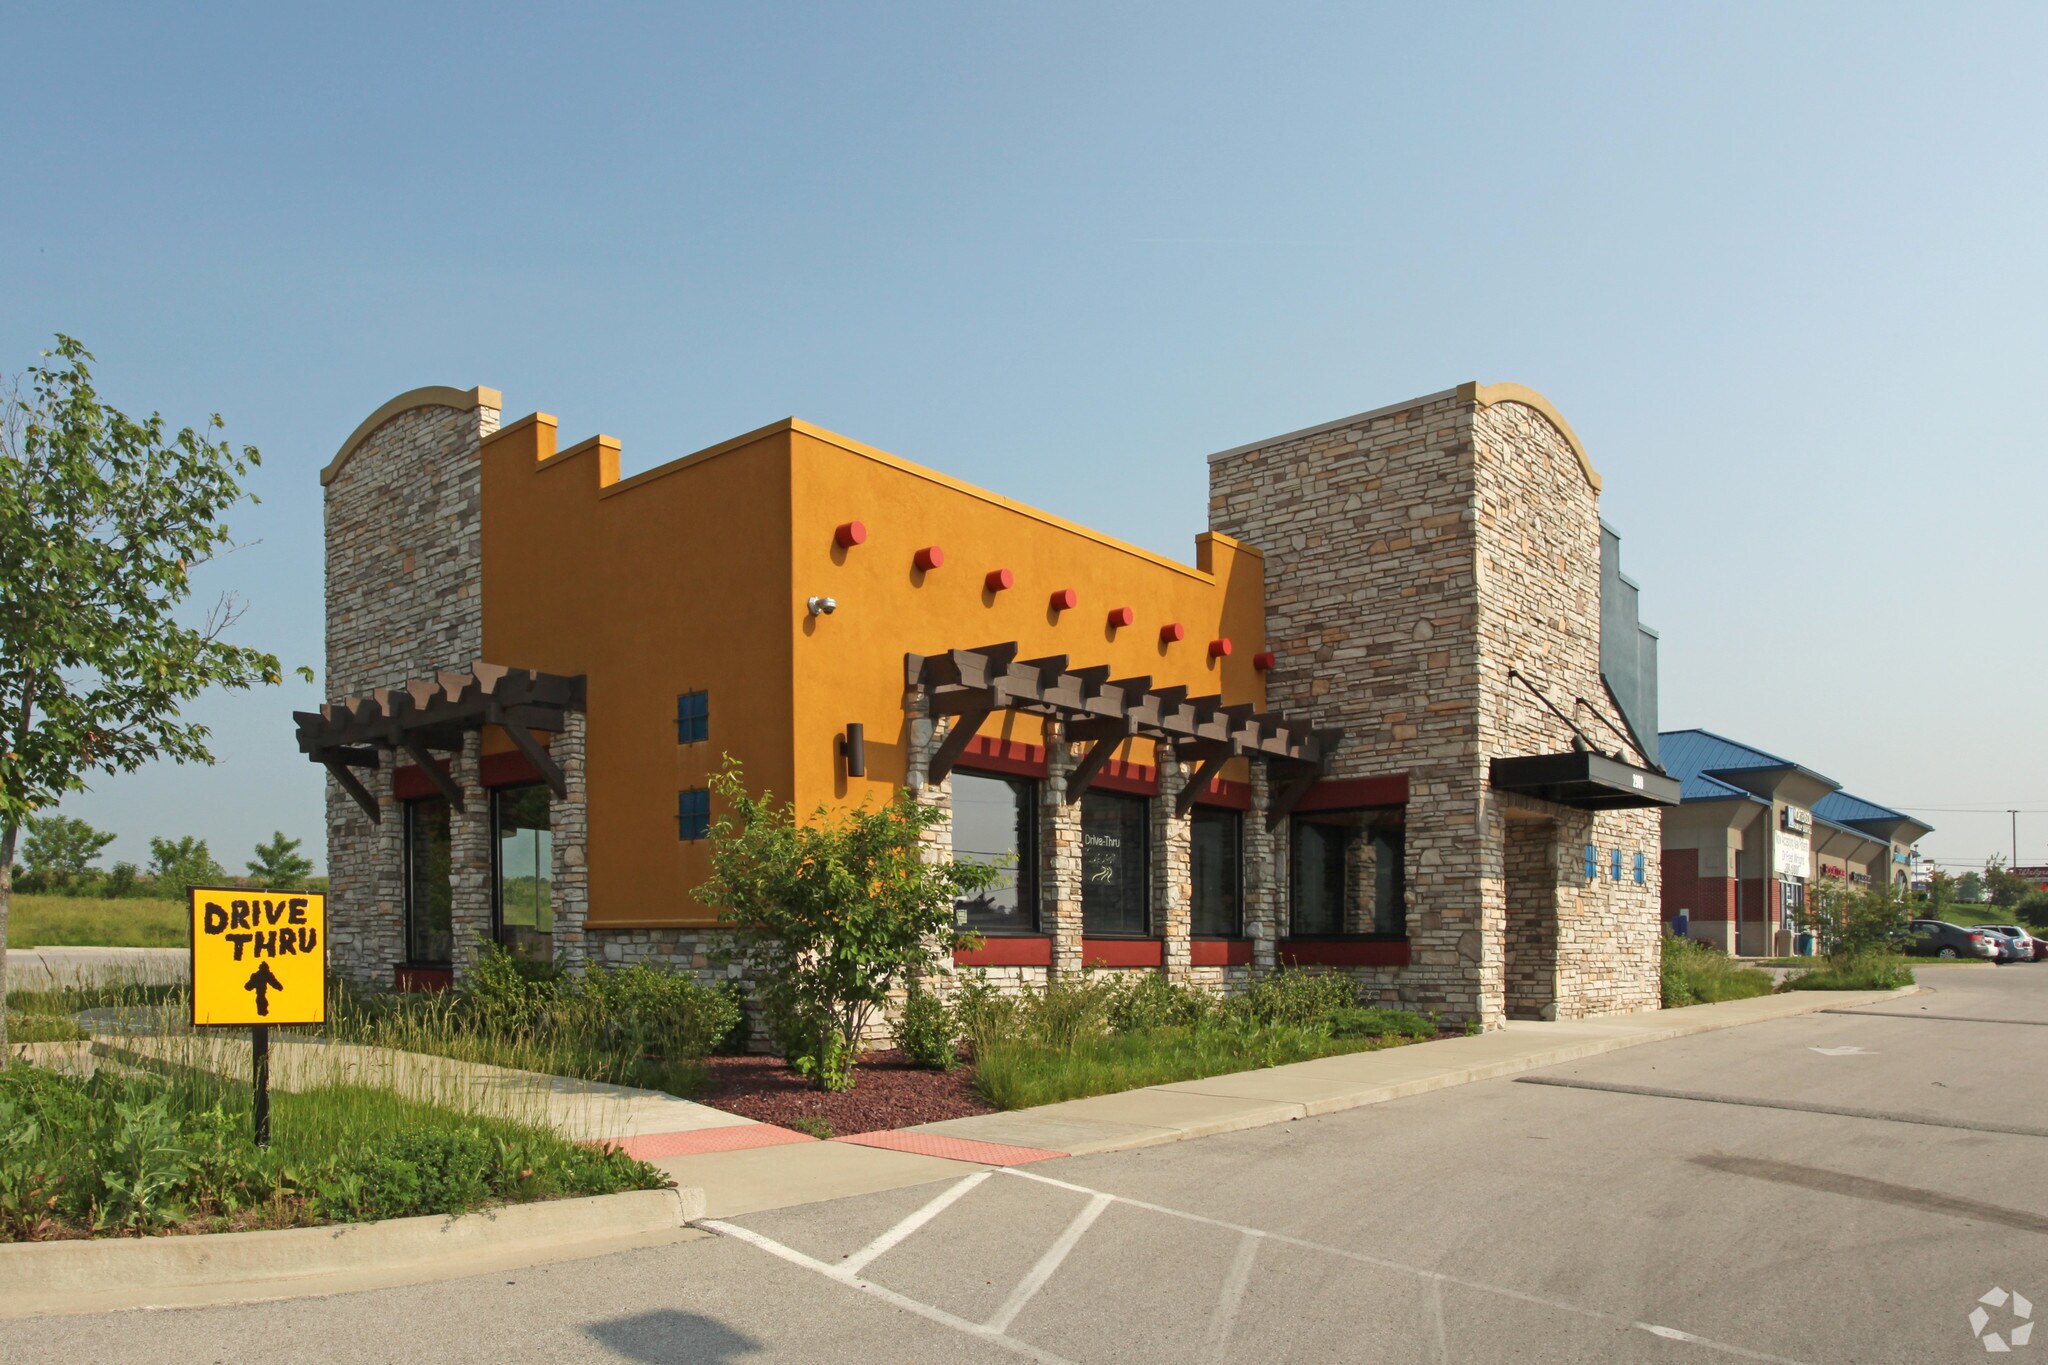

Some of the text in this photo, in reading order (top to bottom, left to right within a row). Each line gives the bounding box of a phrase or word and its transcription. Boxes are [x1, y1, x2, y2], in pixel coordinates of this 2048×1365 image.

[1085, 834, 1120, 847] Drive-Thru
[204, 898, 309, 935] DRIVE
[225, 927, 317, 961] THRU
